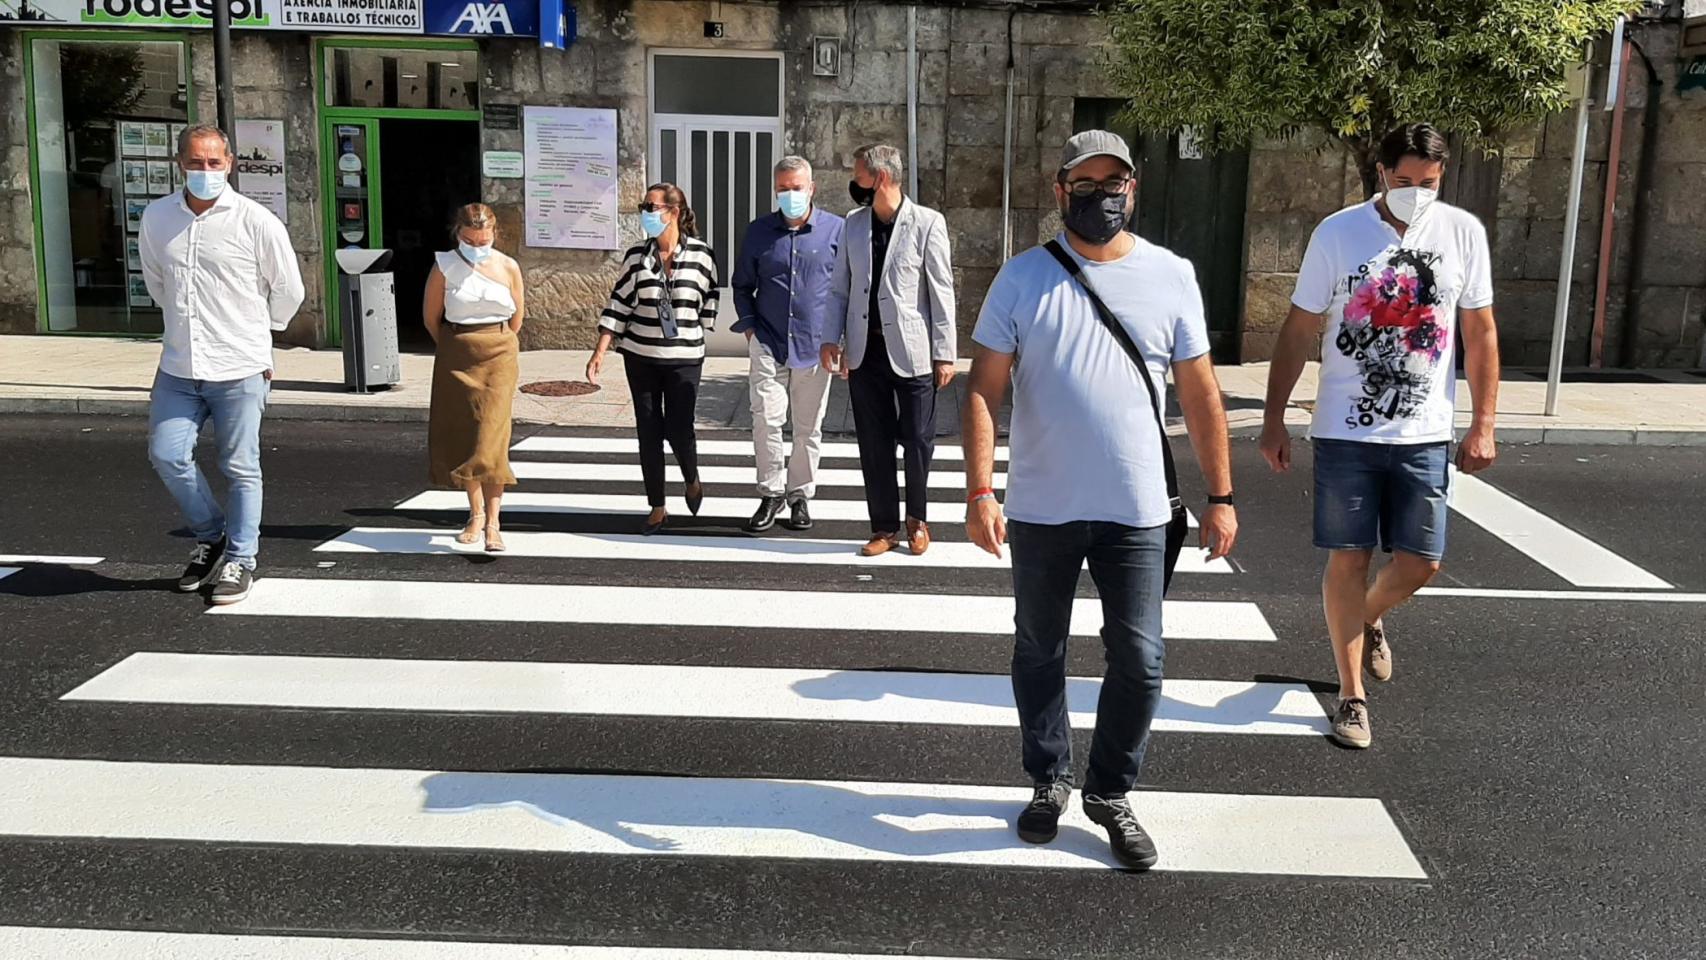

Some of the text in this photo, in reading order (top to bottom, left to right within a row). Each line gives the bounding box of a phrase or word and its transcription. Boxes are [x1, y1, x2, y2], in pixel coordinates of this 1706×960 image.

[338, 0, 417, 10] INMOBILIARIA
[286, 10, 417, 26] E TRABALLOS TÉCNICOS
[449, 2, 514, 34] AXA
[714, 24, 722, 37] 3
[237, 161, 283, 177] despi
